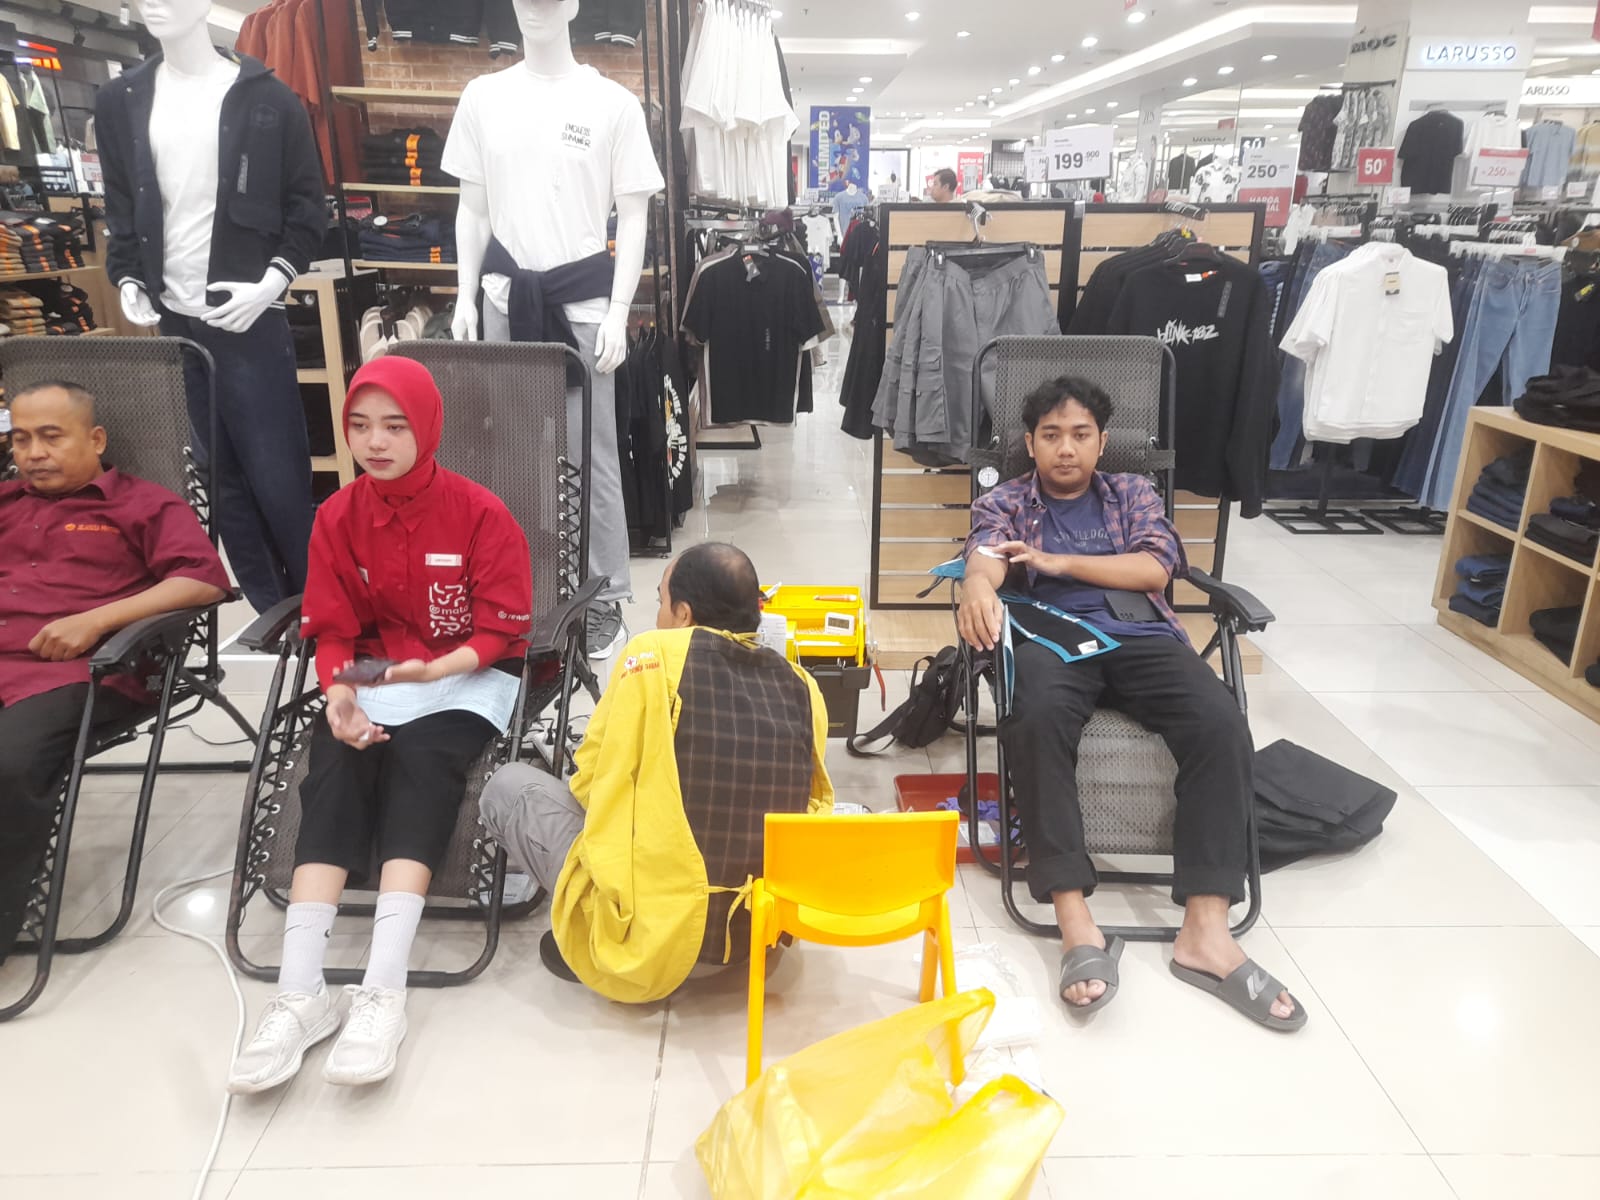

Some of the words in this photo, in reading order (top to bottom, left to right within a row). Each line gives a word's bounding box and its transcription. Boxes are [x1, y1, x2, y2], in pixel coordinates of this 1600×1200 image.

[1425, 44, 1517, 62] LARUSSO
[1524, 84, 1571, 97] ARUSSO
[1054, 152, 1084, 171] 199
[1246, 164, 1278, 179] 250
